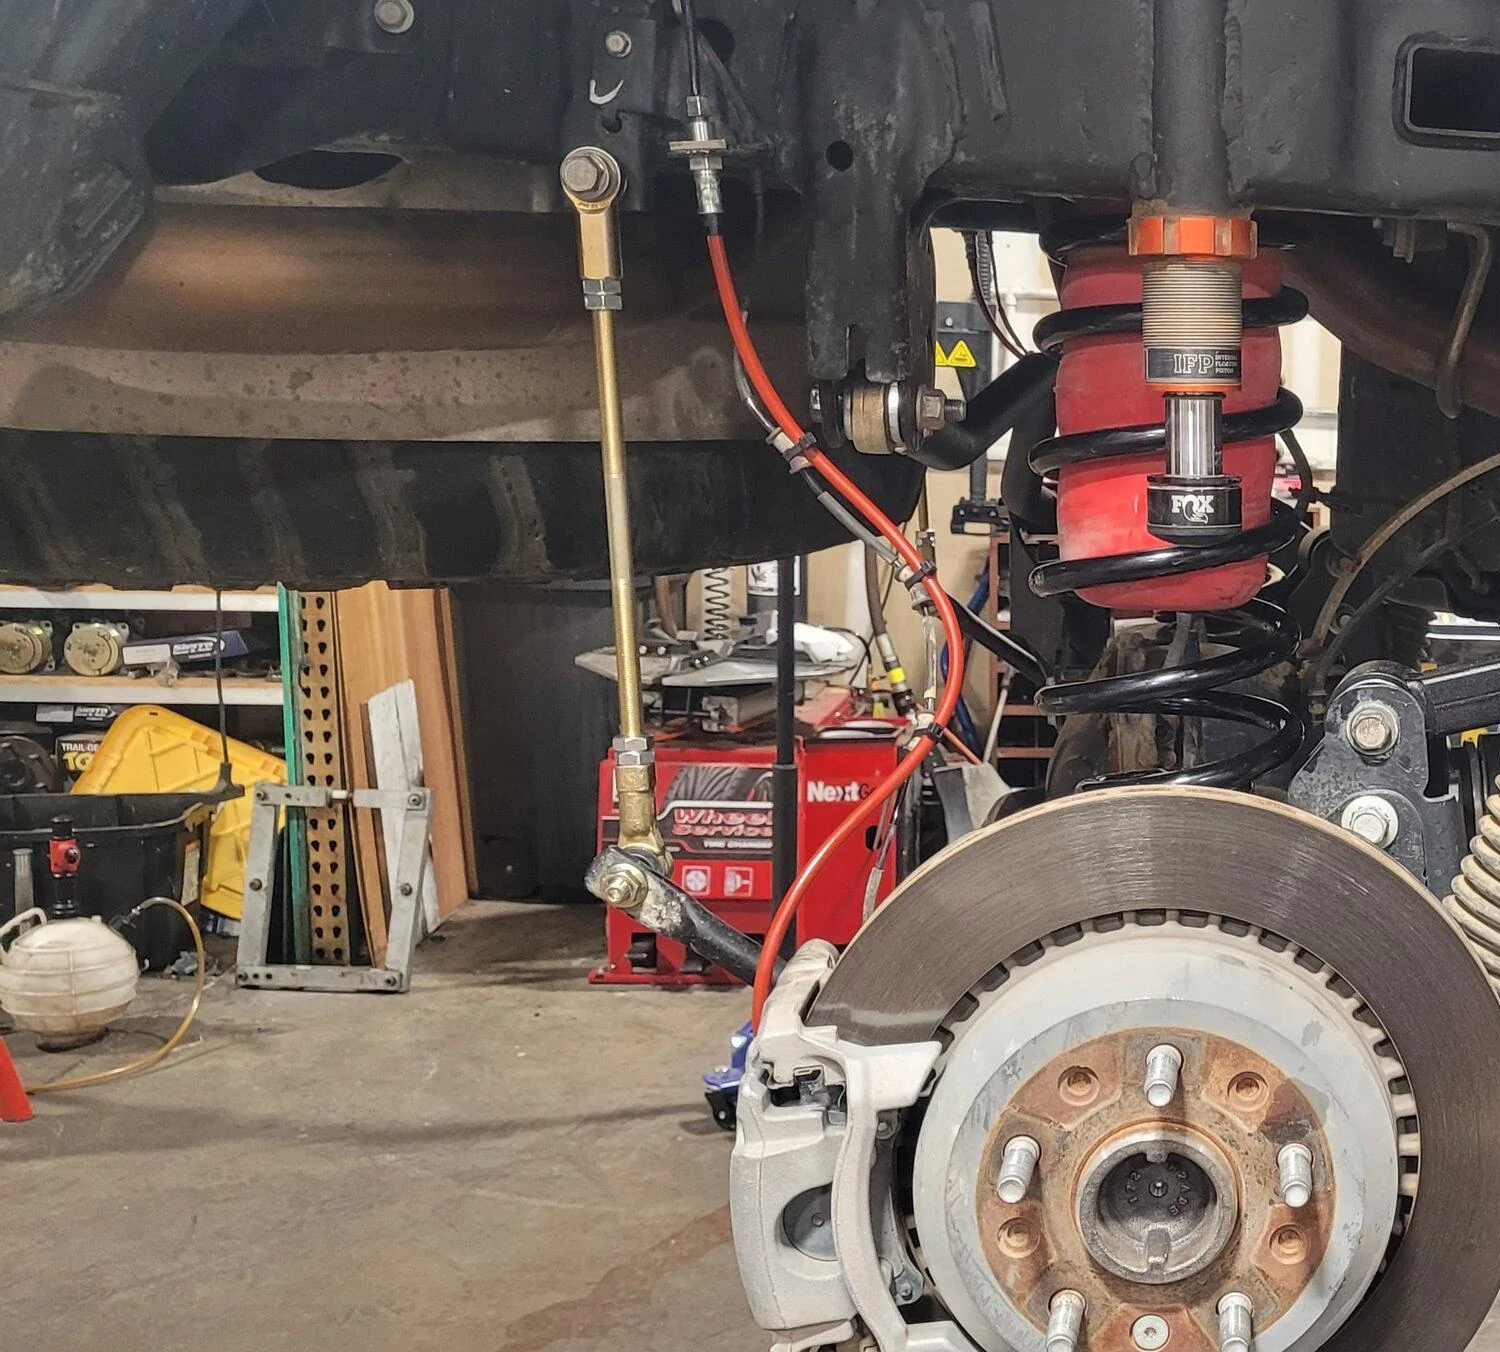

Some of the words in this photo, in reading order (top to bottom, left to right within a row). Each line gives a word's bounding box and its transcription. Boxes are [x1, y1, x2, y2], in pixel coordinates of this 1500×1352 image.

[1173, 353, 1214, 374] IFP
[1171, 494, 1214, 524] FOX
[673, 808, 773, 826] Wheel
[671, 823, 774, 837] Service
